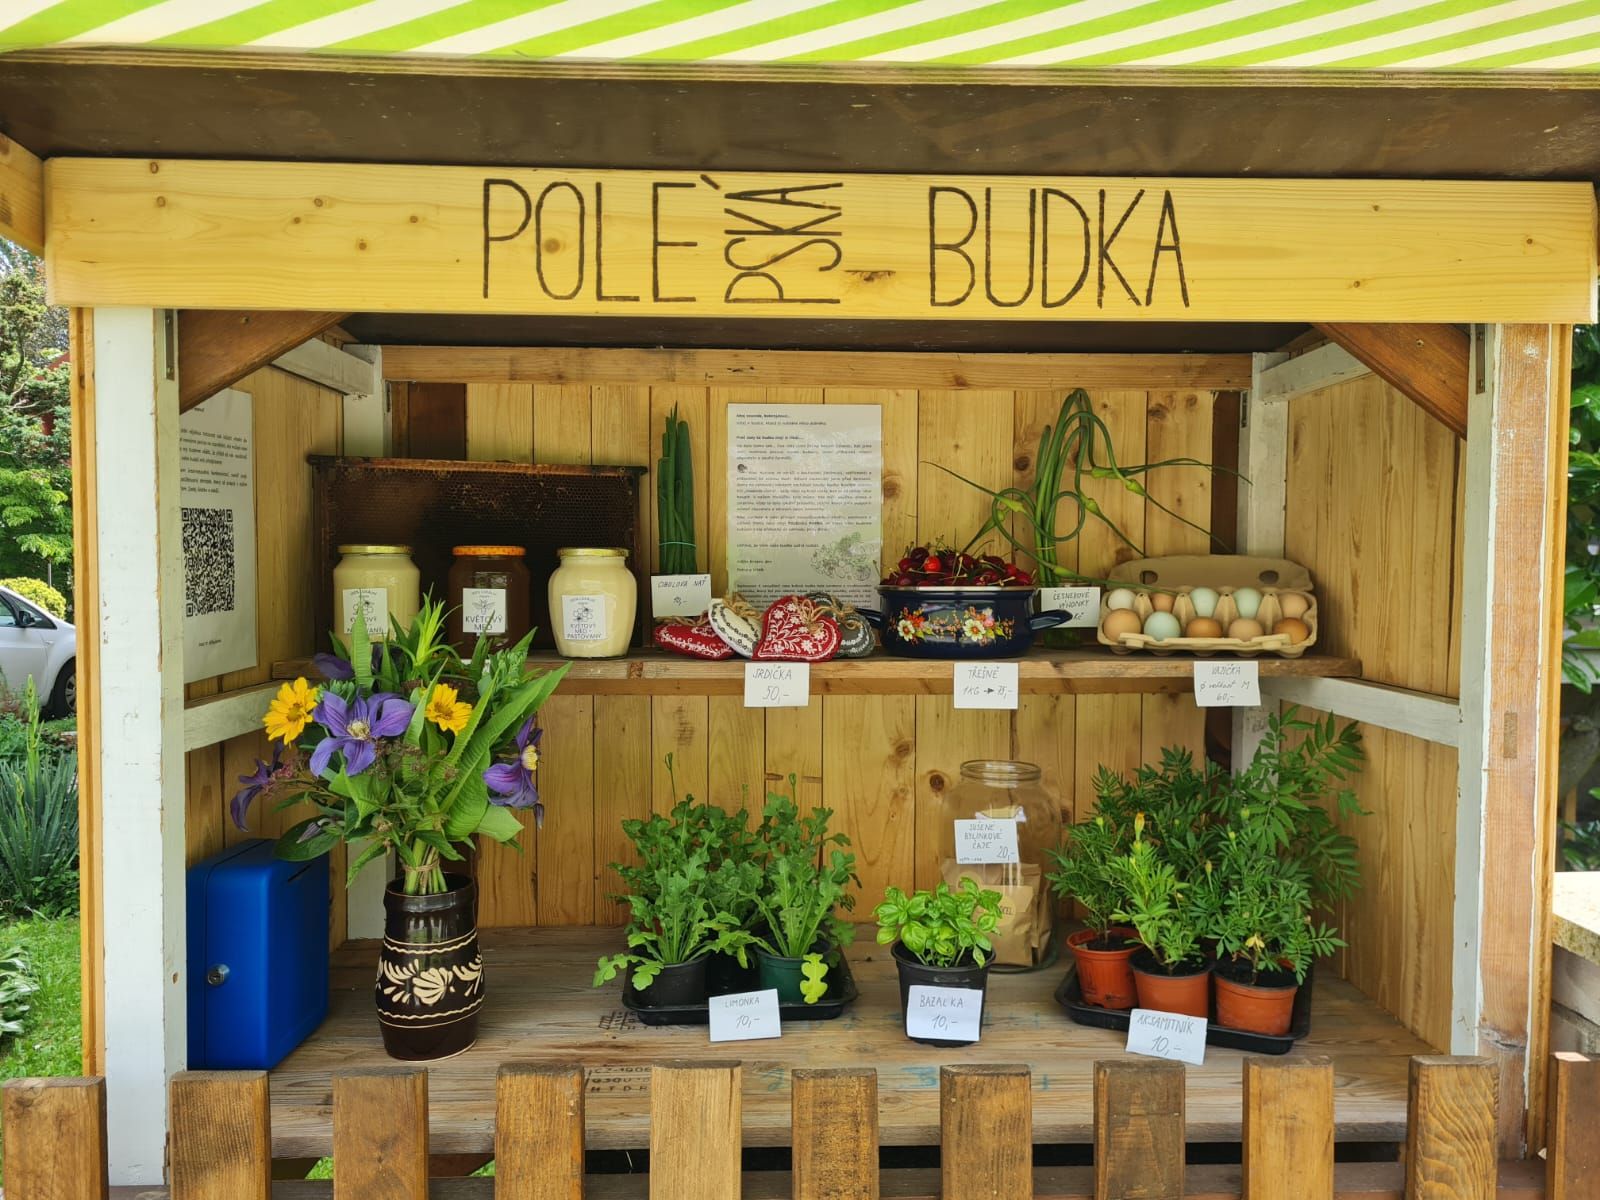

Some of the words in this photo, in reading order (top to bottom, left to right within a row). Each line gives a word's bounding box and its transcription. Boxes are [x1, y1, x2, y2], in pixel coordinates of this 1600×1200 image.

[929, 186, 1190, 308] BUDKA
[752, 664, 792, 680] SRDÍČKA
[724, 996, 760, 1008] LIMONKA
